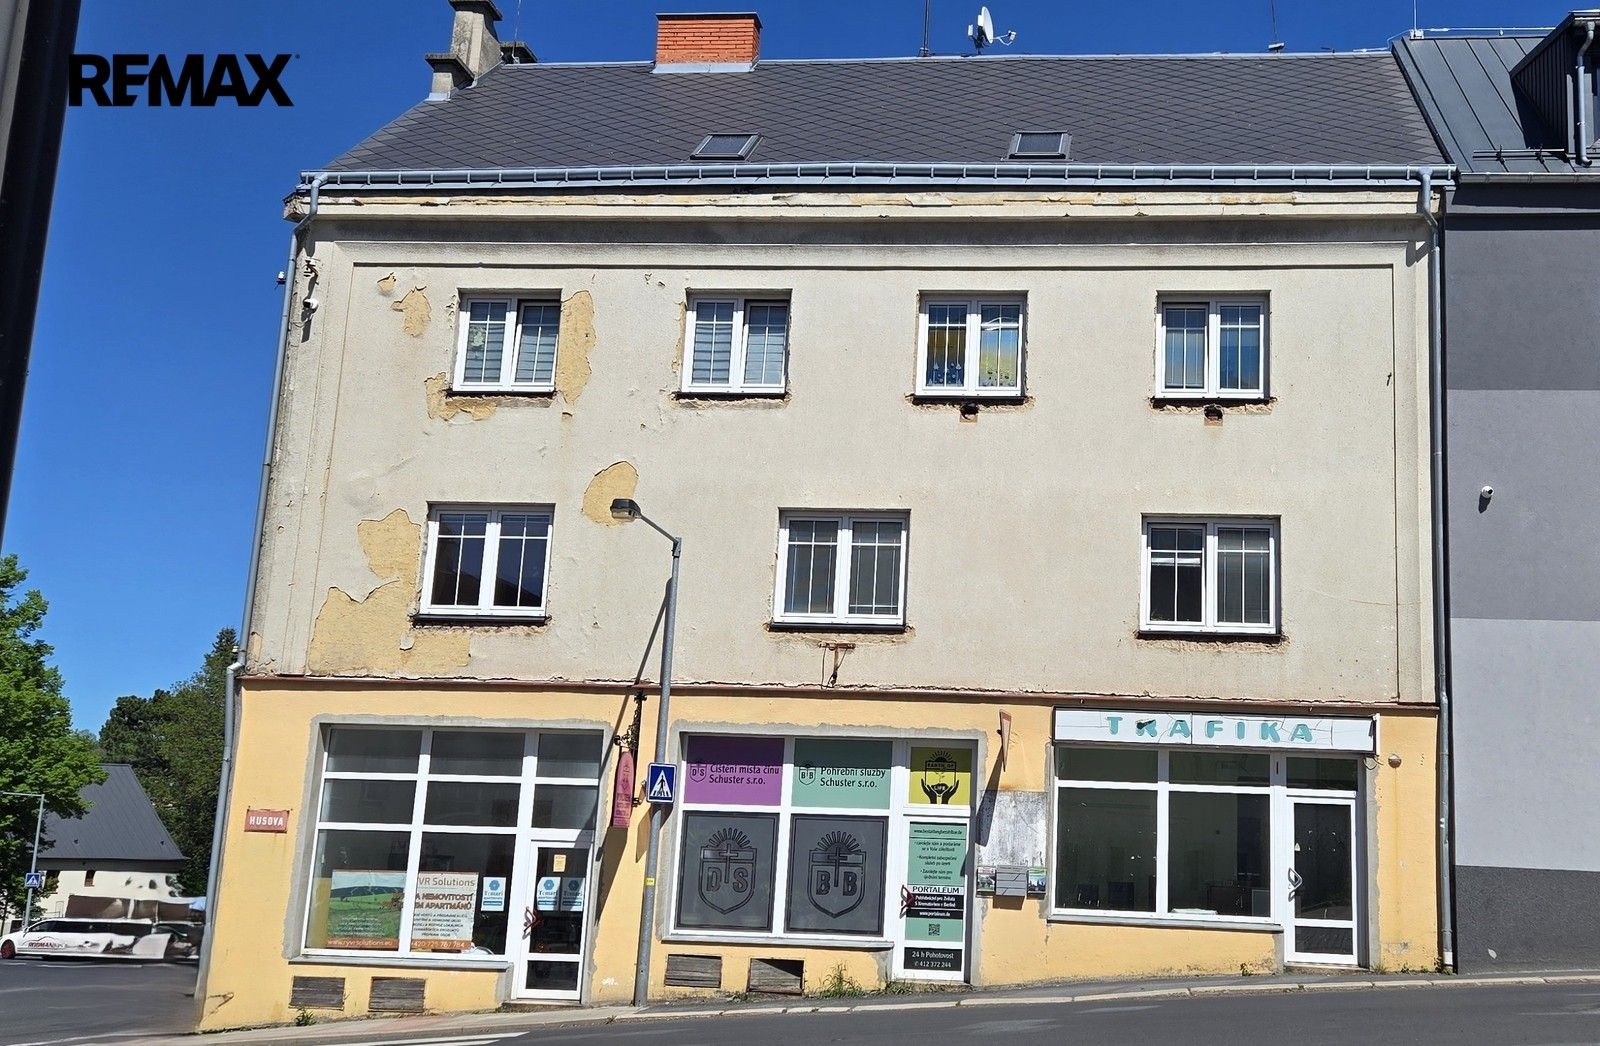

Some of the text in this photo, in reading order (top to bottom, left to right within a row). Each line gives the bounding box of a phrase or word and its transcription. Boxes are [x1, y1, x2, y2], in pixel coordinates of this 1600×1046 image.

[709, 774, 766, 785] Schuster s.r.o.
[820, 777, 878, 788] Schuster s.r.o.
[249, 816, 284, 826] HUSOVA
[433, 878, 476, 887] Solutions
